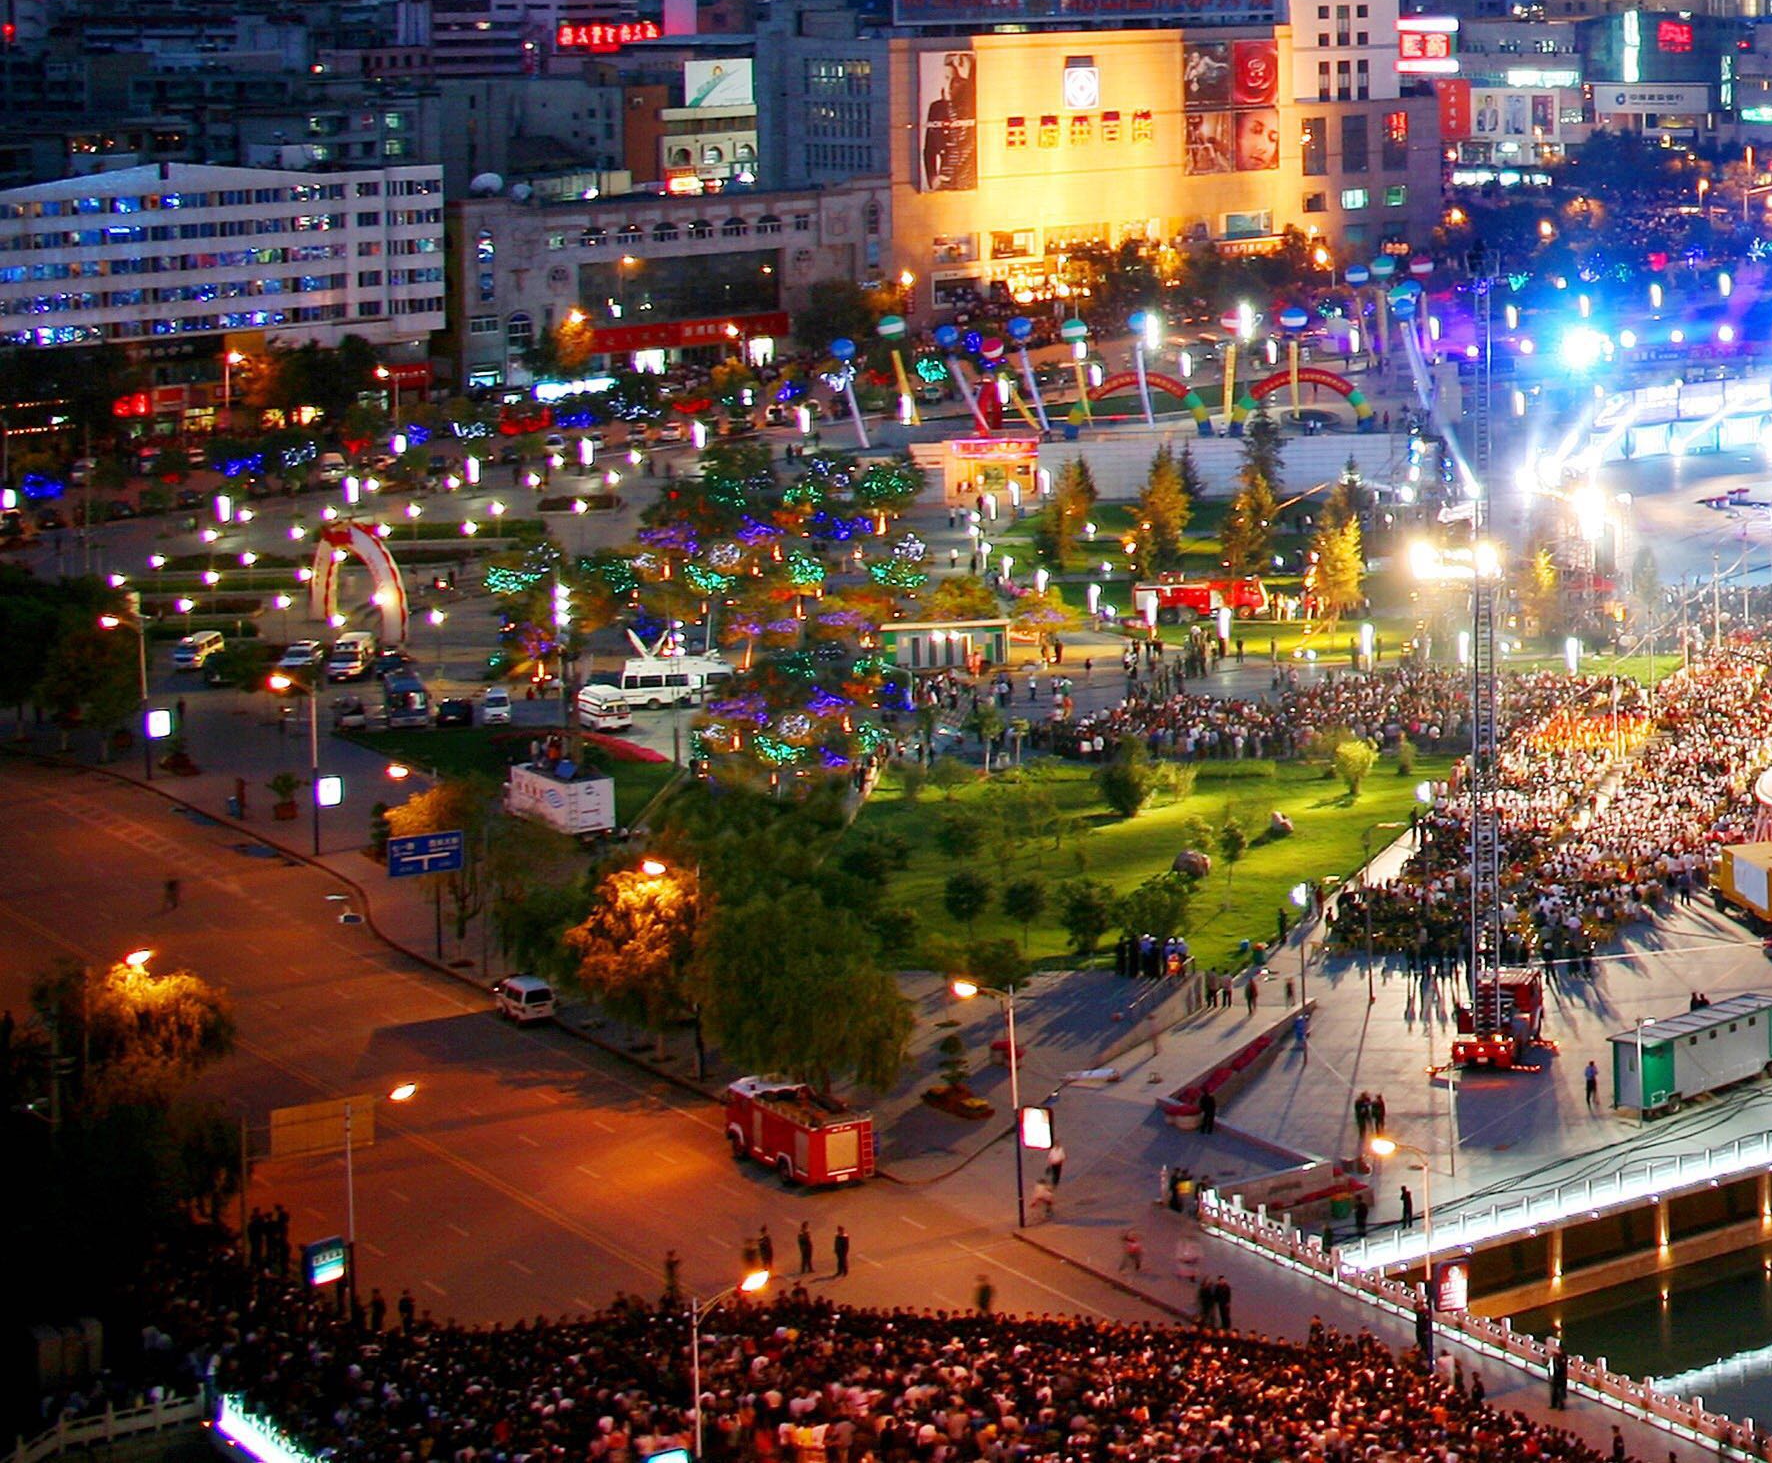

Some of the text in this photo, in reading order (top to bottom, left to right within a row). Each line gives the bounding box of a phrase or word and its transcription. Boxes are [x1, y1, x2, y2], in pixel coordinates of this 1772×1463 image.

[1401, 33, 1448, 58] 医药
[1006, 109, 1153, 148] 王府井百货
